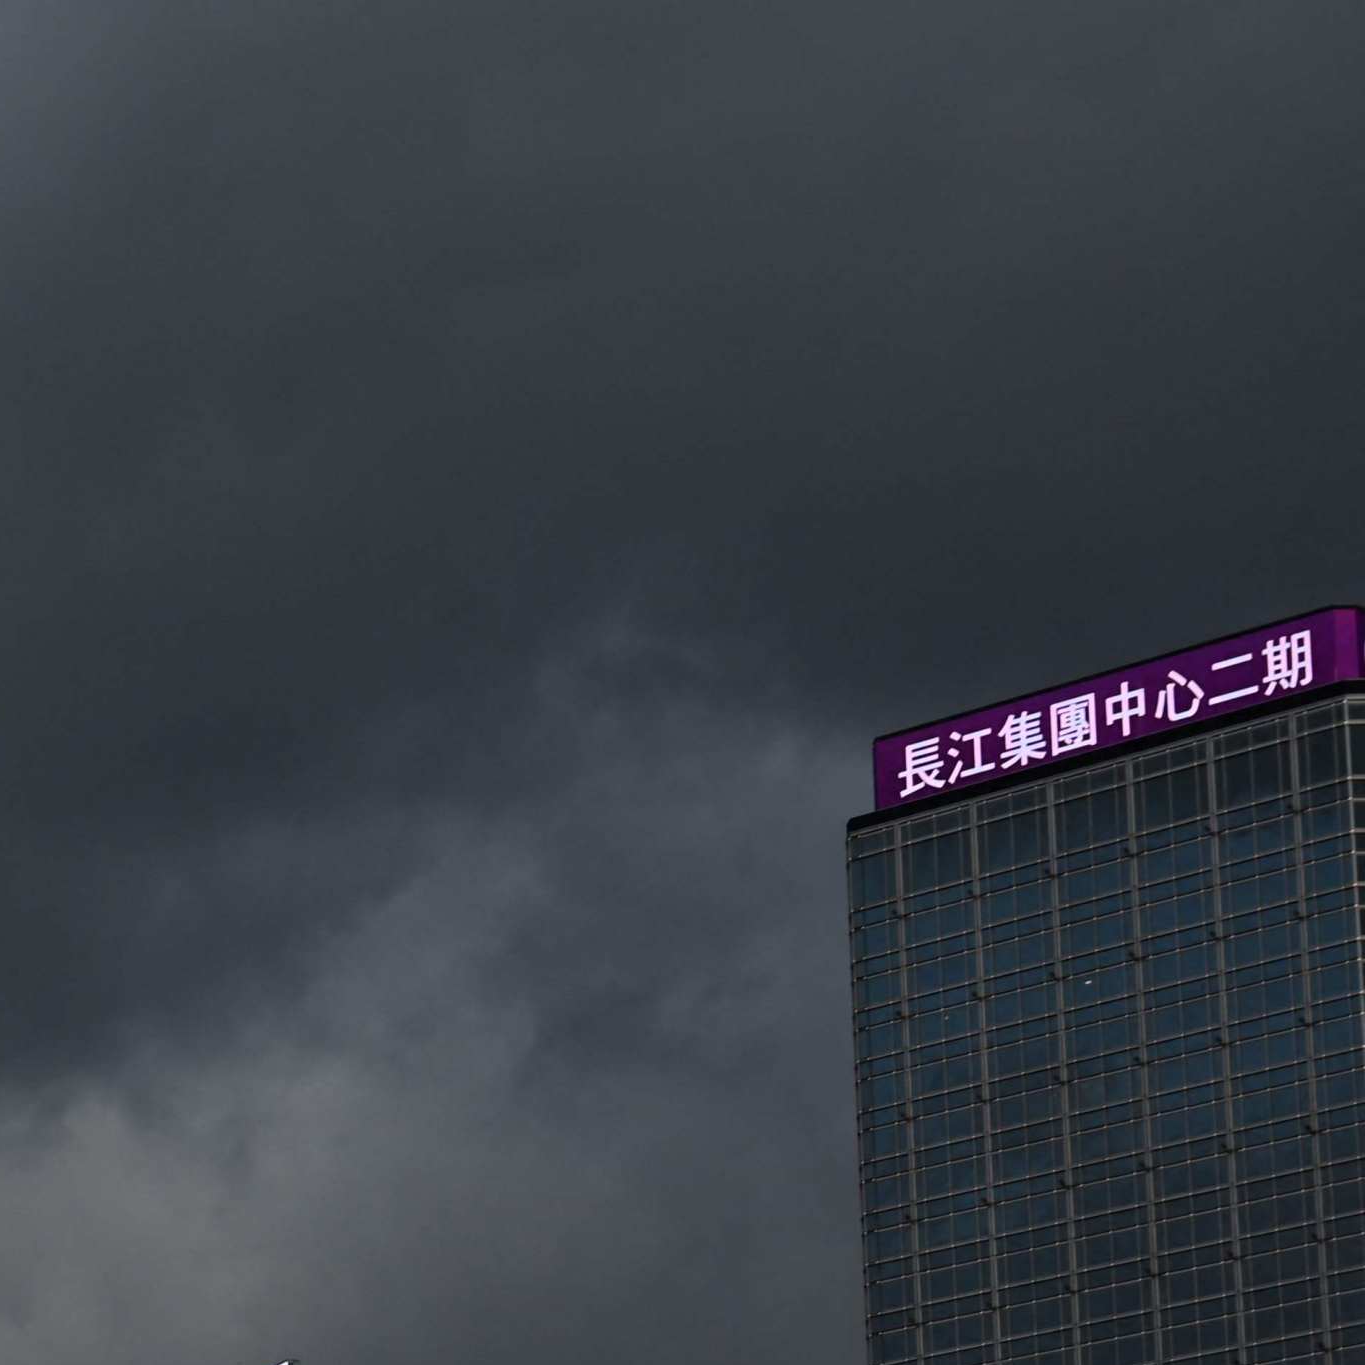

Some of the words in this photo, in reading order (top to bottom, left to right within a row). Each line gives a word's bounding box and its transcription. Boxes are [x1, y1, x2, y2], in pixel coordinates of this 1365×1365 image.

[897, 629, 1314, 798] 長江集團中心二期
